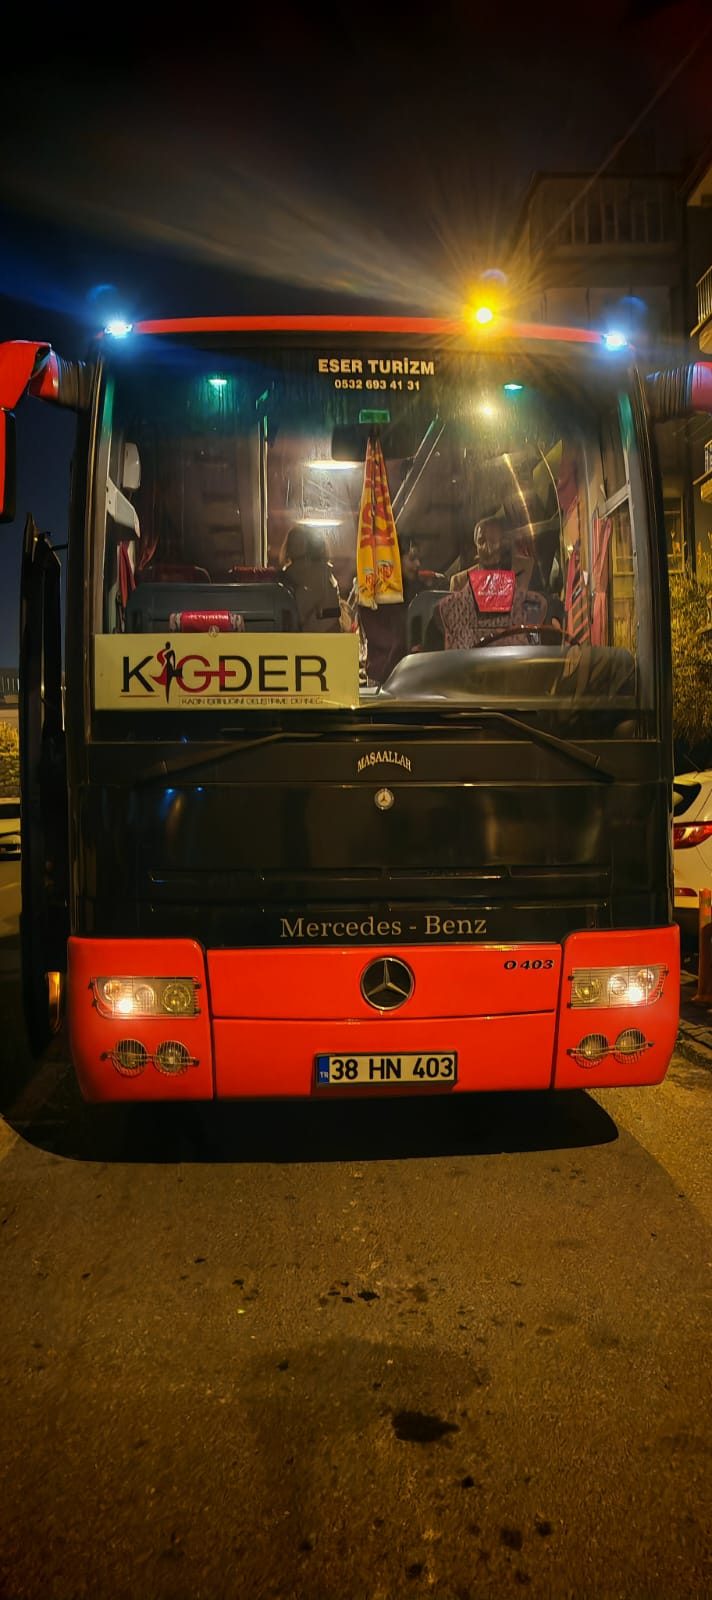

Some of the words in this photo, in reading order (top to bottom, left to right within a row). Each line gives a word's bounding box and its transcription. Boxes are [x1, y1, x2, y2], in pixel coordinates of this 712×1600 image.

[318, 358, 363, 373] ESER
[367, 356, 435, 375] TURİZM
[334, 379, 363, 389] 0532
[365, 379, 387, 390] 693
[389, 380, 403, 391] 41
[407, 380, 420, 391] 31
[279, 917, 402, 938] Mercedes
[424, 915, 487, 935] Benz
[520, 960, 554, 970] 403
[331, 1058, 358, 1080] 38
[369, 1058, 402, 1080] HN
[413, 1056, 454, 1078] 403
